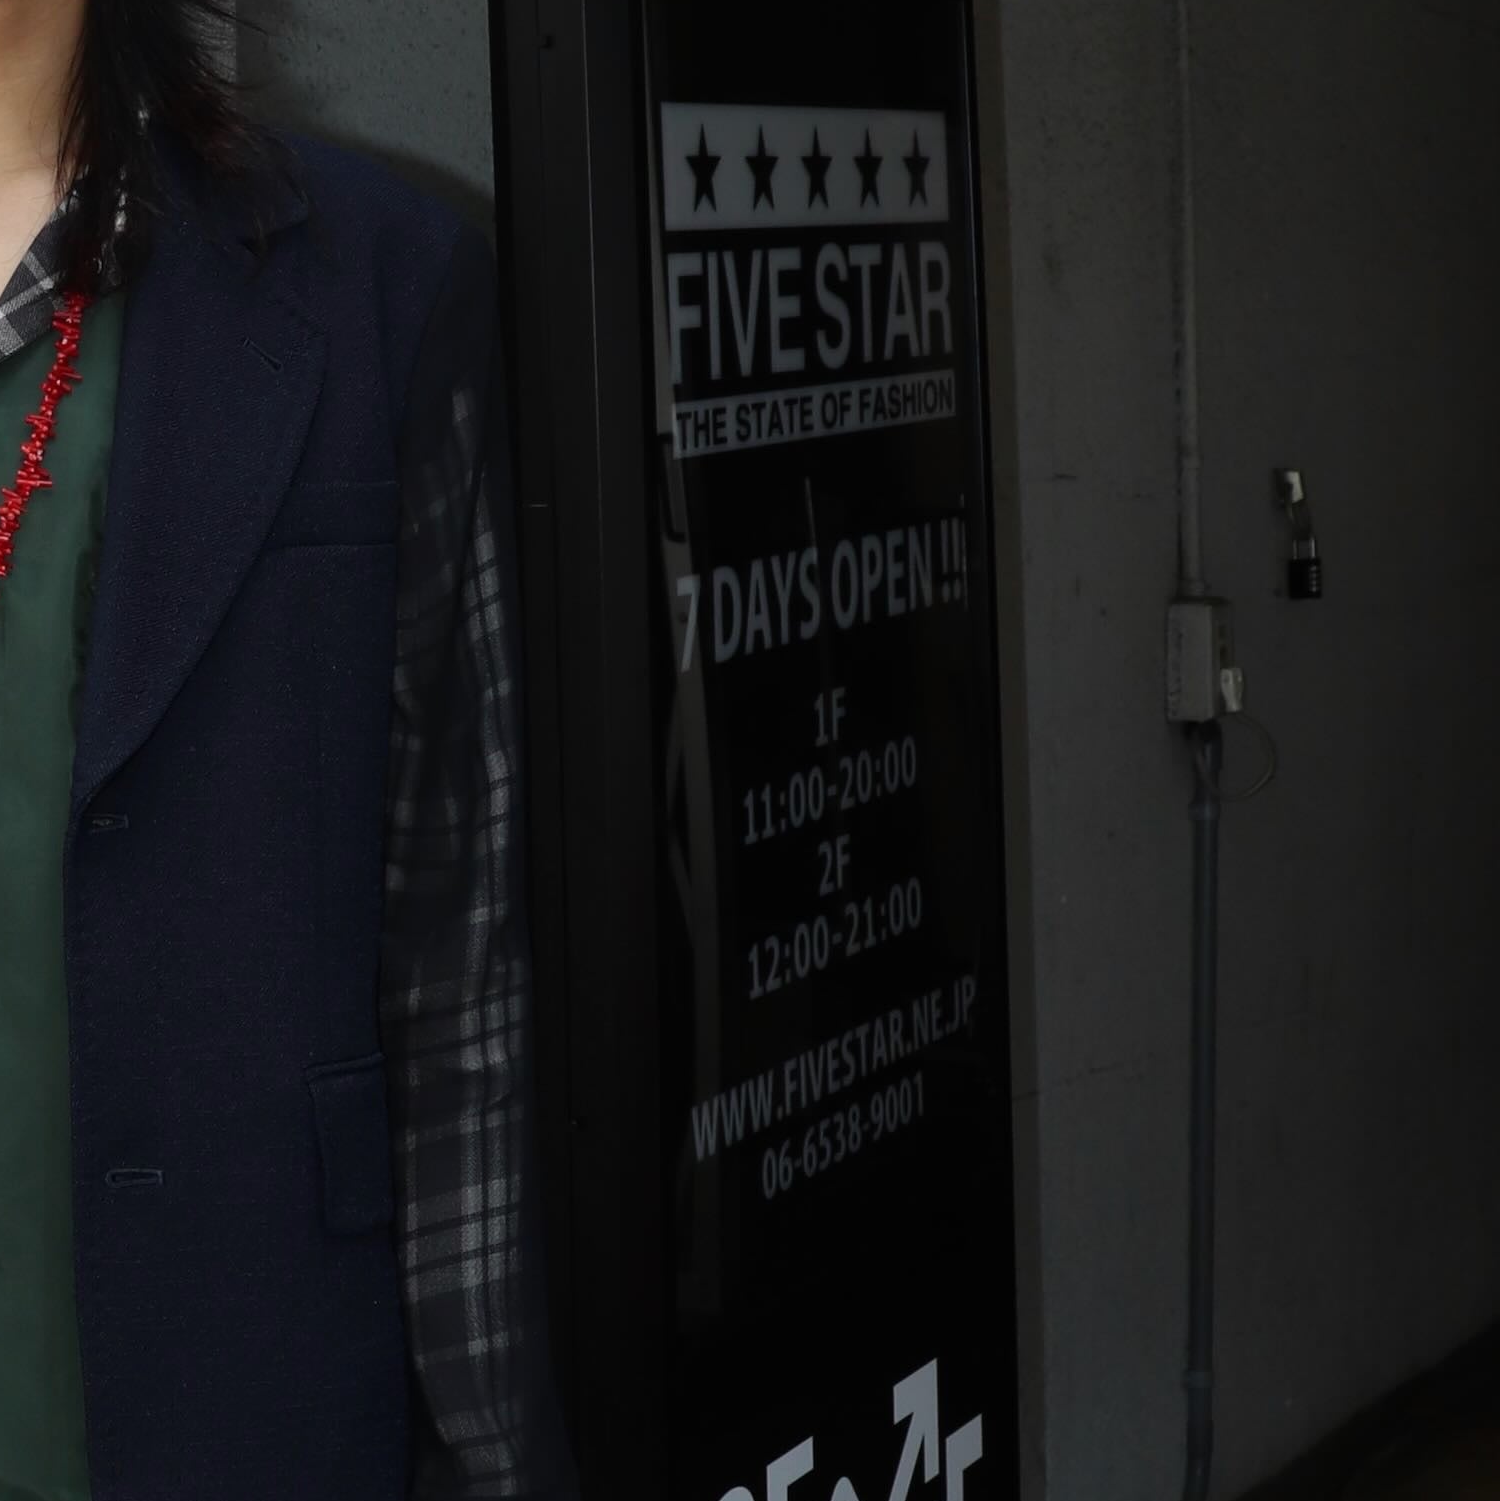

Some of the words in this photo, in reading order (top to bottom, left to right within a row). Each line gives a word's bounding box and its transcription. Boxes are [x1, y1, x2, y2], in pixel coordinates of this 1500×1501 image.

[667, 247, 805, 385] FIVE
[815, 240, 953, 370] STAR
[676, 409, 727, 450] THE
[736, 396, 813, 442] STATE
[821, 390, 851, 430] OF
[859, 377, 953, 423] FASHION
[676, 574, 701, 674] 7
[711, 546, 821, 664] DAYS
[813, 687, 848, 748] 1F
[743, 734, 917, 846] 11:00-20:00
[817, 833, 851, 898] 2F
[748, 876, 923, 1000] 12:00-21:00
[691, 974, 978, 1162] WWW.FIVESTAR.NE.JP
[761, 1069, 924, 1201] 06-6538-9001
